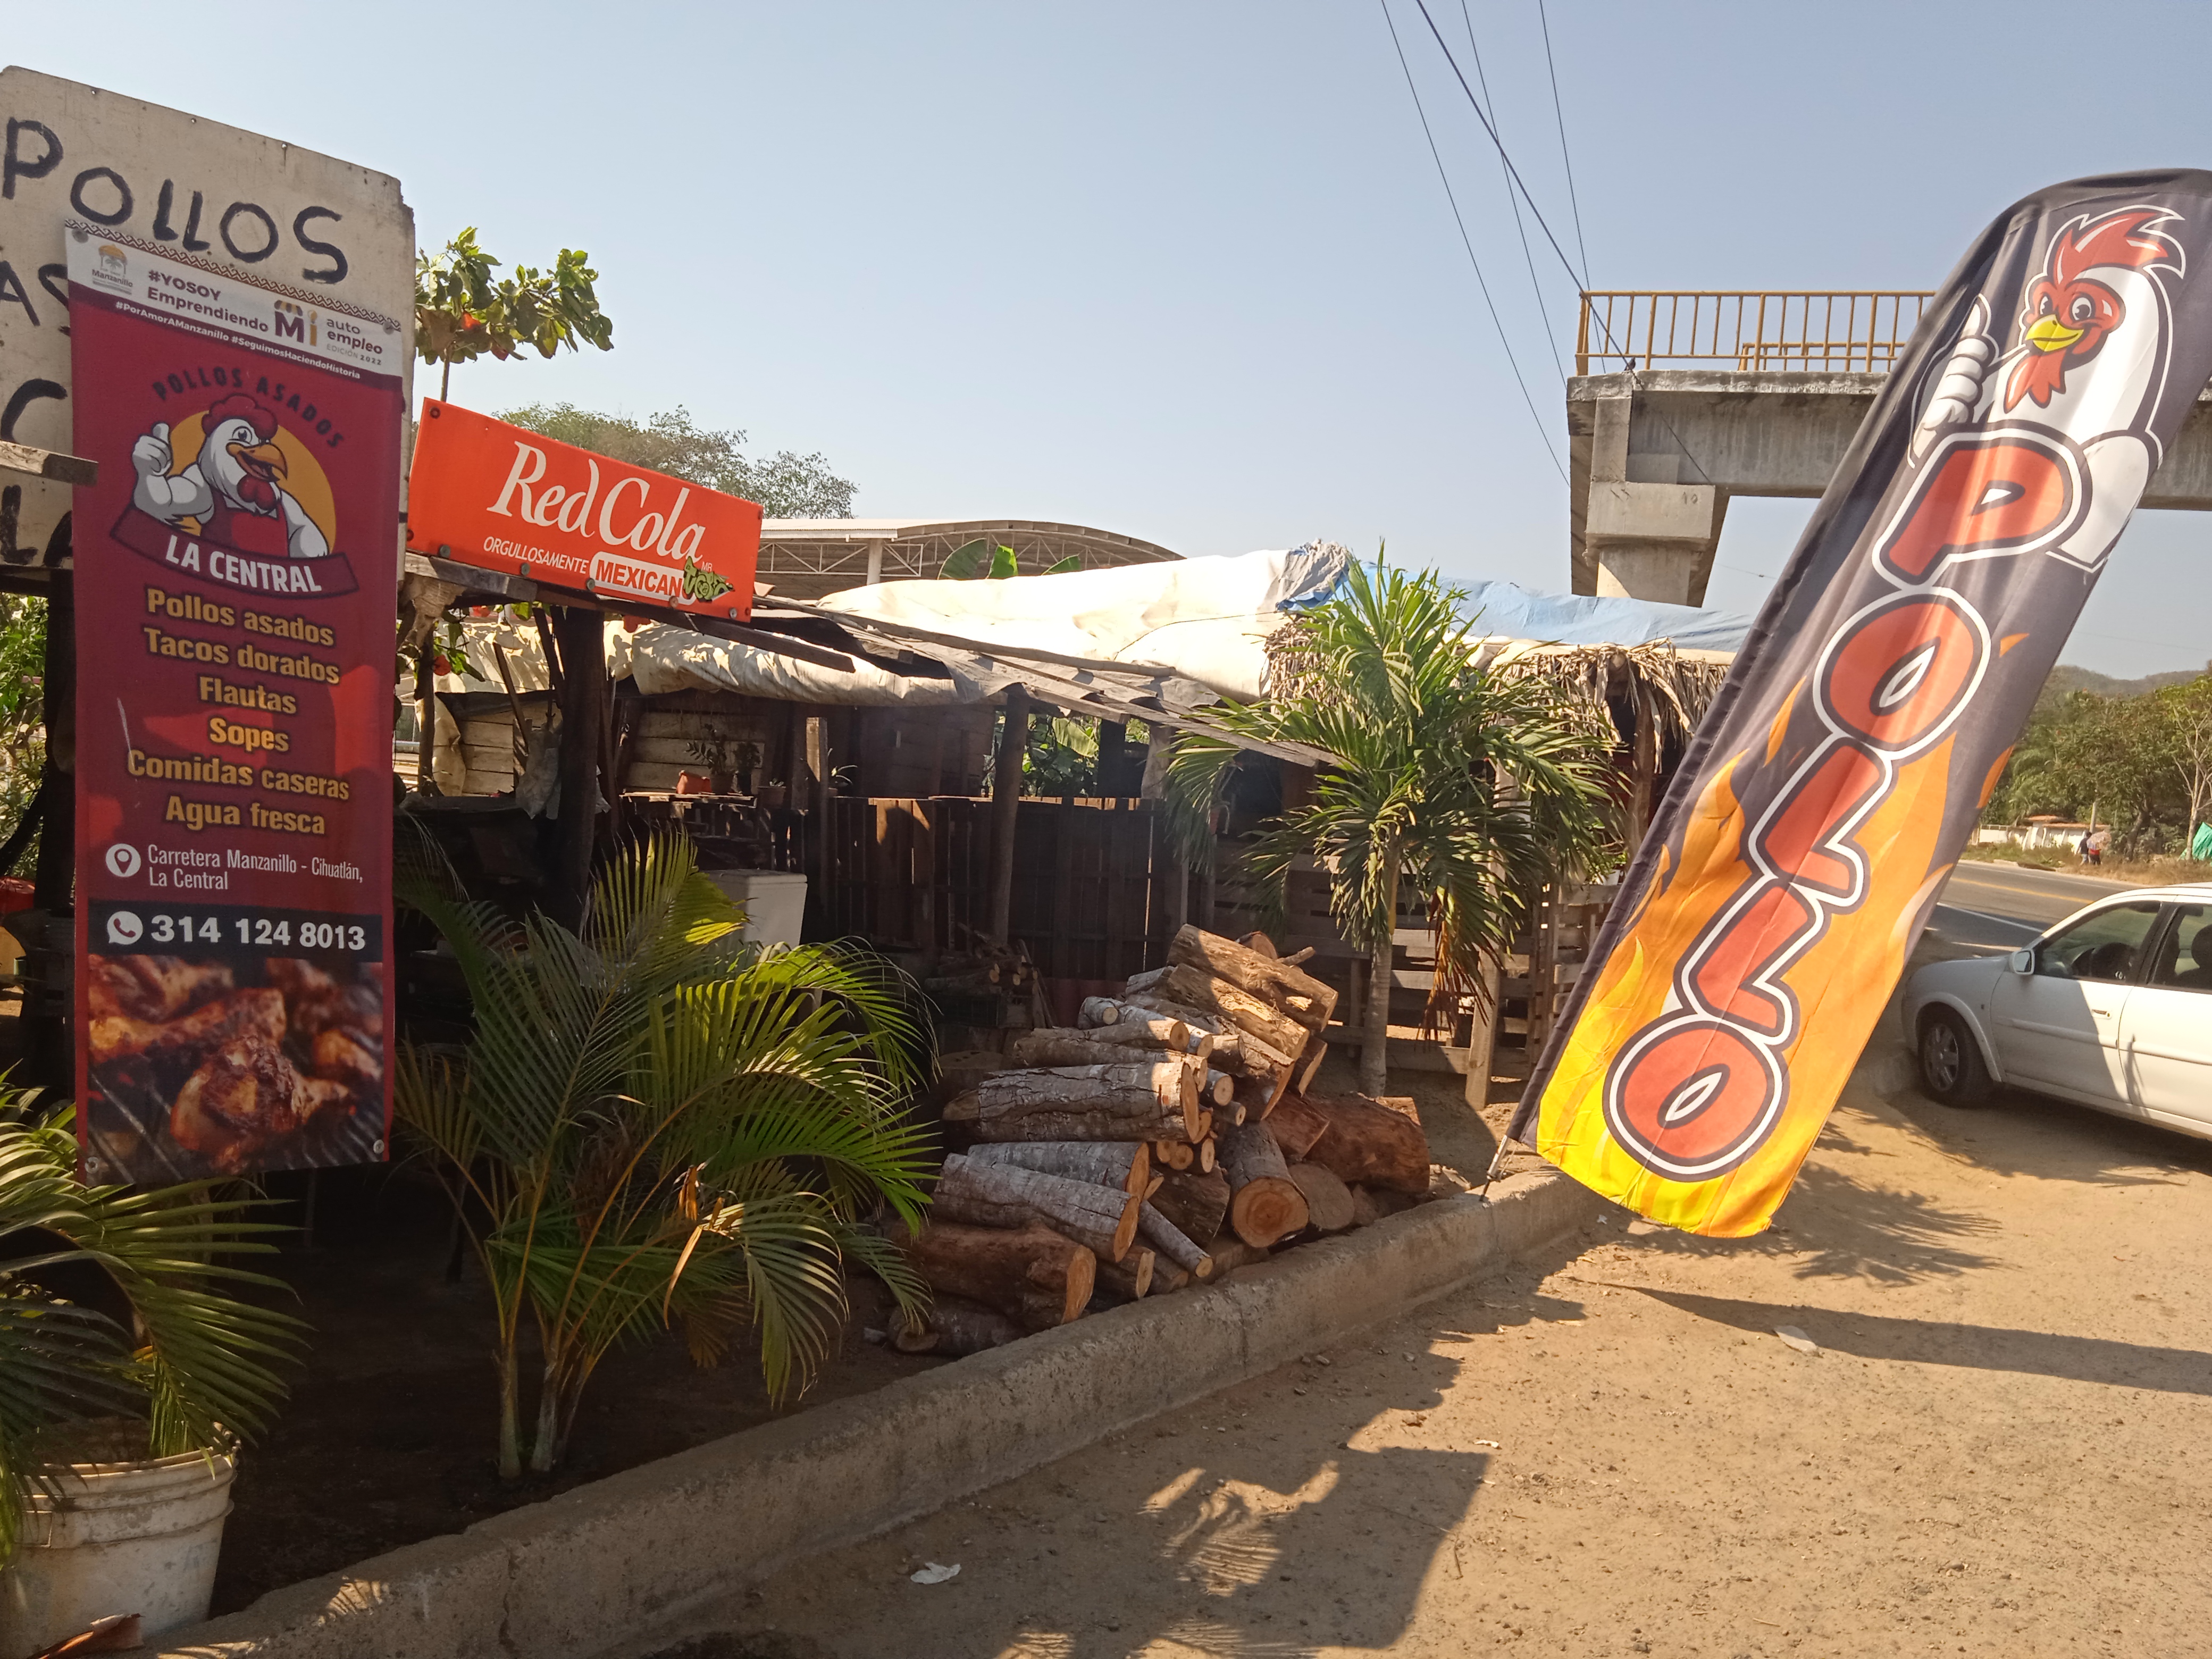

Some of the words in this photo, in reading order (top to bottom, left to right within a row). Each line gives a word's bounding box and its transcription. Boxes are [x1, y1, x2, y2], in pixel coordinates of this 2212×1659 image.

[2, 116, 348, 284] POLLOS
[92, 269, 133, 287] Manzanillo
[148, 270, 221, 301] #YOSOY
[148, 287, 269, 332] Emprendiendo
[326, 319, 361, 334] auto
[115, 301, 229, 341] #PorAmorAManzanillo
[231, 336, 361, 379] #SeguimosHaciendoHistoria
[326, 344, 358, 358] EDICIÓN
[360, 354, 382, 365] 2022
[328, 330, 383, 354] empleo
[152, 366, 243, 400] POLLOS
[256, 376, 343, 448] ASADOS
[165, 535, 200, 572] LA
[210, 551, 322, 593] CENTRAL
[483, 536, 590, 574] ORGULLOSAMENTE
[596, 559, 691, 599] MEXICAN
[701, 561, 713, 572] MR
[147, 588, 236, 626] Pollos
[244, 611, 334, 646] asados
[144, 627, 229, 664] Tacos
[237, 644, 340, 684] dorados
[199, 676, 297, 714] Flautas
[210, 718, 289, 752] Sopes
[128, 750, 253, 786] Comidas
[262, 769, 349, 800] caseras
[166, 796, 241, 831] Agua
[250, 802, 325, 834] fresca
[1603, 426, 2092, 1175] POLLO
[148, 844, 220, 867] Carretera
[227, 849, 297, 873] Manzanillo
[312, 857, 363, 883] Cihuatlán,
[149, 867, 167, 886] La
[173, 868, 228, 890] Central
[150, 915, 221, 943] 314
[235, 918, 291, 945] 124
[299, 923, 366, 950] 8013
